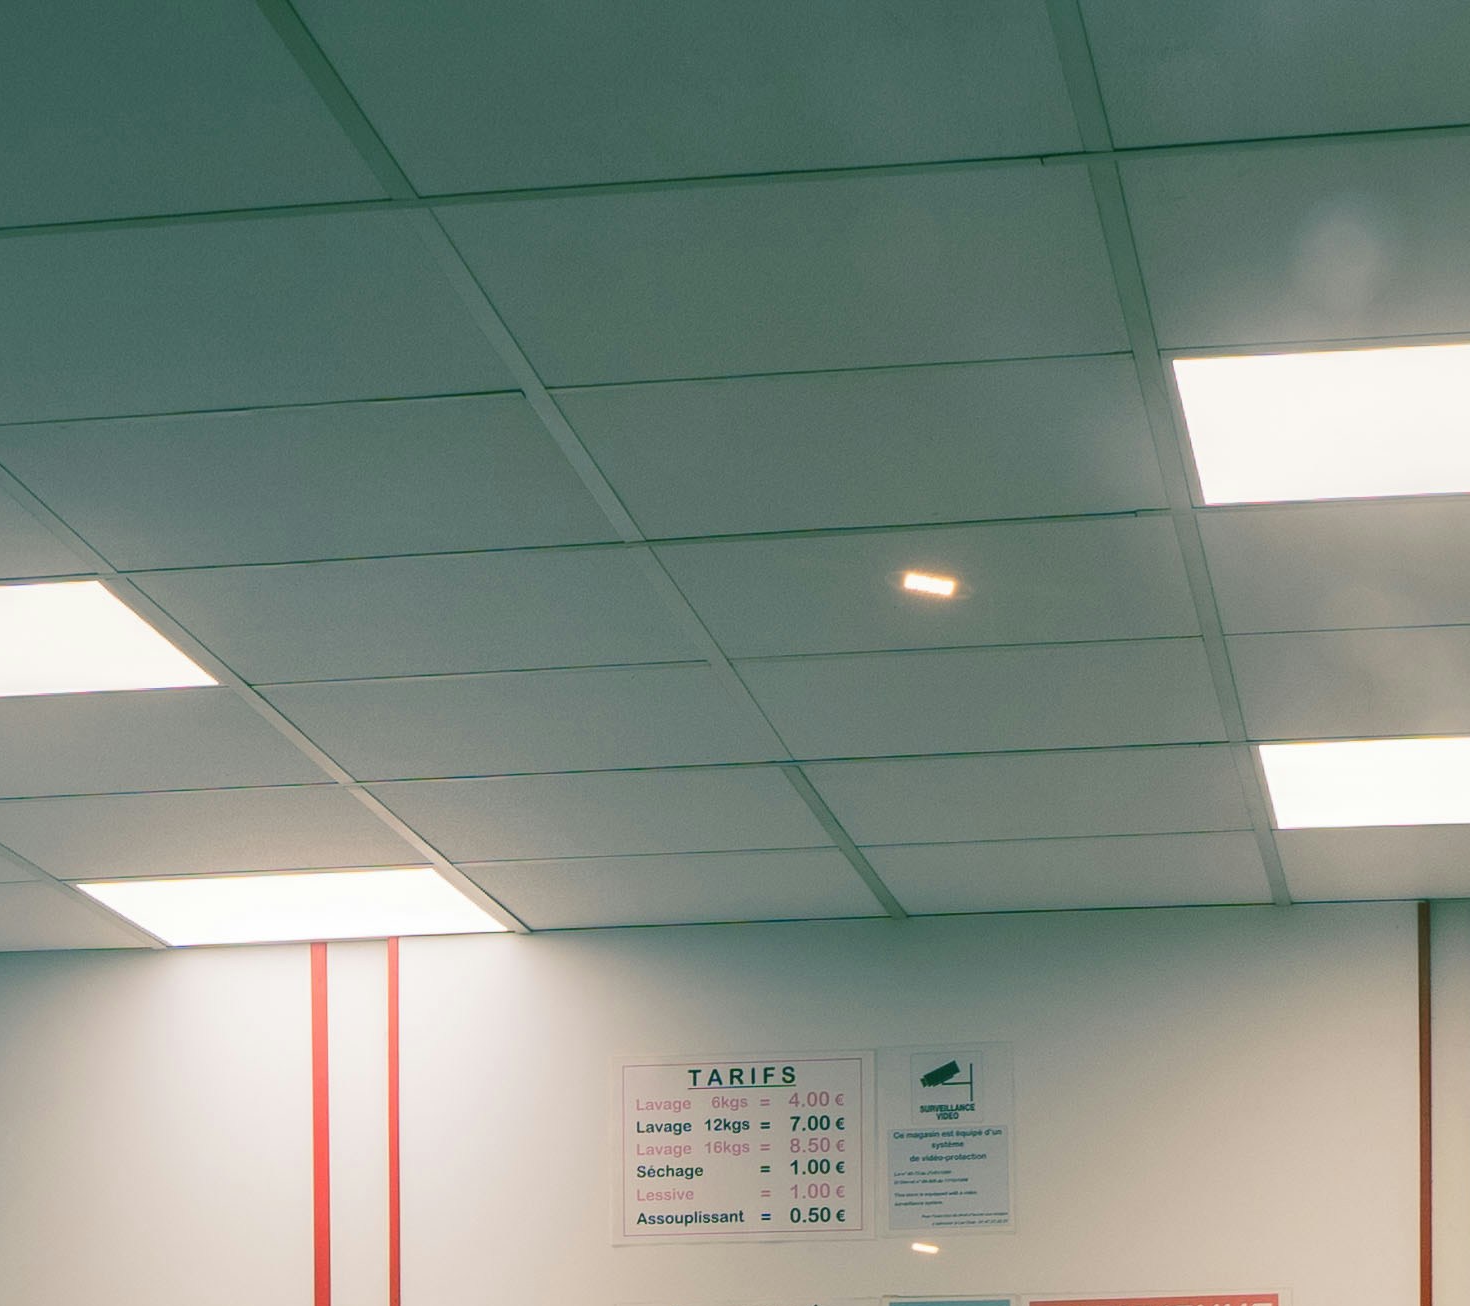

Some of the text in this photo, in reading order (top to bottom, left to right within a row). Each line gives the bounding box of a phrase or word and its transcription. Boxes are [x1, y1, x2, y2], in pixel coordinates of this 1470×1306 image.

[687, 1065, 797, 1087] TARIFS
[635, 1091, 830, 1113] Lavage 6kgs 4.00
[920, 1103, 975, 1113] SURVEILLANCE
[636, 1115, 831, 1136] Lavage 12kgs 7.00
[636, 1137, 831, 1158] Lavage 16kgs 8.50
[636, 1158, 831, 1179] Séchage 1.00
[636, 1183, 831, 1202] Lessive 1.00
[636, 1207, 831, 1228] Assouplissant 0.50
